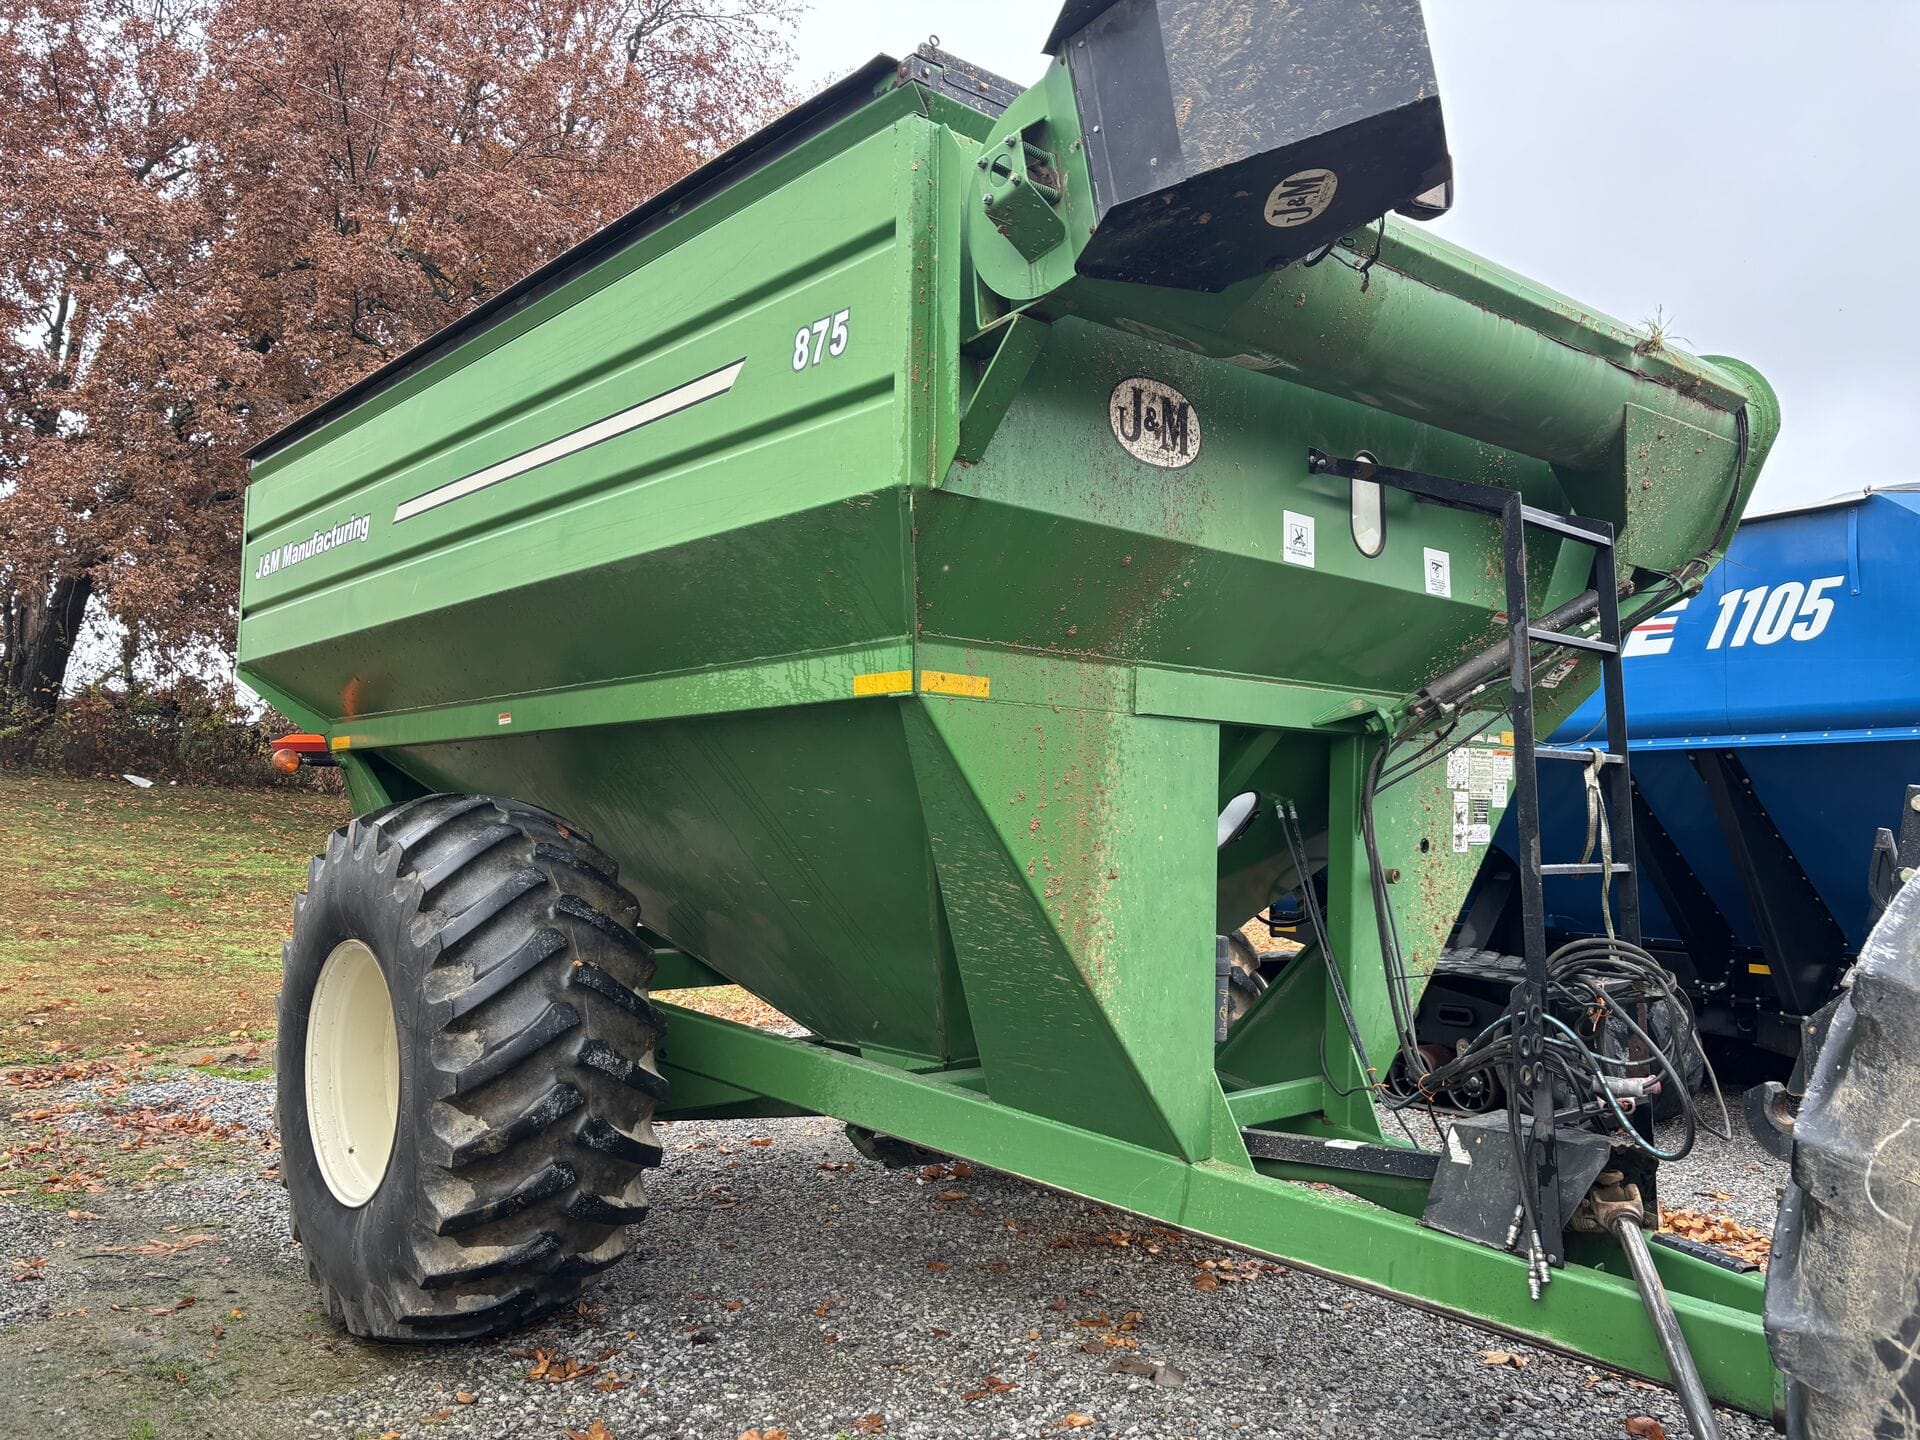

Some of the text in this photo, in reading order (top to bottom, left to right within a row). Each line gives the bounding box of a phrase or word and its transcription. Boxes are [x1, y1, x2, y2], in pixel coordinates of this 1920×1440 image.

[1271, 173, 1326, 223] J&M
[792, 307, 850, 372] 875
[1117, 386, 1189, 456] J&M
[255, 512, 371, 580] J&M Manufacturing
[1706, 575, 1844, 650] 1105
